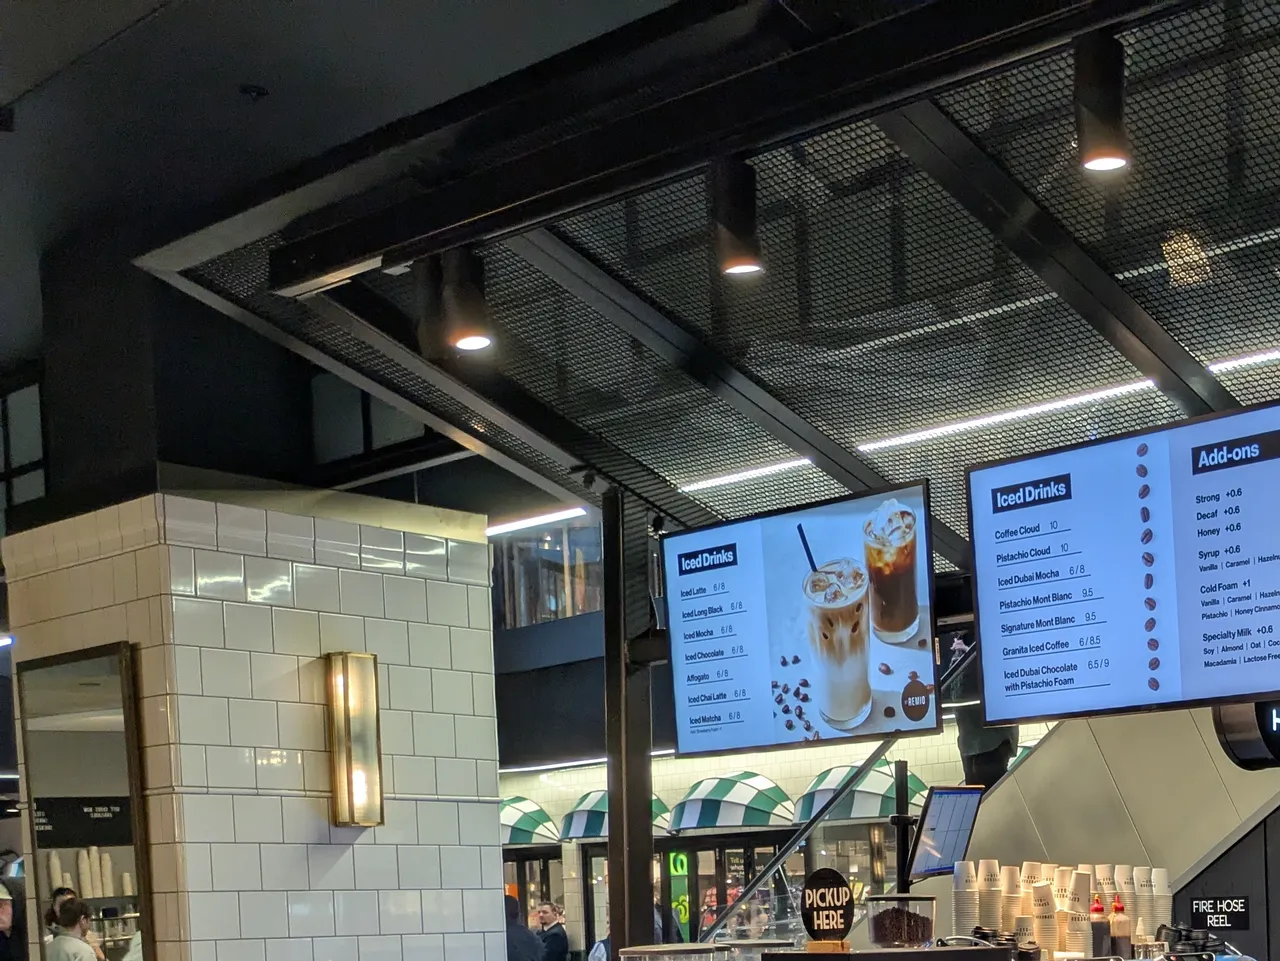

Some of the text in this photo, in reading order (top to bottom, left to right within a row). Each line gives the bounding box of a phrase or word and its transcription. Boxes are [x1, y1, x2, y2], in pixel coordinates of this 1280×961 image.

[1198, 444, 1260, 468] Add-ons
[997, 481, 1066, 507] Iced Drinks
[1196, 488, 1242, 504] Strong +0.6
[1197, 505, 1240, 520] Decaf +0.6
[995, 520, 1058, 539] Coffee Cloud 10
[1197, 522, 1242, 537] Honey +0.6
[682, 549, 734, 571] Iced Drinks
[996, 543, 1069, 563] Pistachio Cloud 10
[1198, 545, 1241, 560] Syrup +0.6
[1199, 563, 1218, 572] Vanilla
[1225, 558, 1250, 568] Caramel
[998, 576, 1013, 587] Iced
[1014, 573, 1035, 584] Dubai
[1035, 569, 1060, 580] Mocha
[680, 588, 692, 597] Iced
[692, 587, 707, 596] Latte
[1200, 579, 1251, 594] Cold Foam +1
[999, 588, 1094, 610] Pistachio Mont Blanc 9.5
[1201, 598, 1220, 607] Vanilla
[1227, 593, 1252, 603] Caramel
[682, 609, 694, 619] Iced
[694, 608, 708, 617] Long
[708, 605, 723, 615] Black
[1201, 610, 1229, 620] Pistachio
[1234, 606, 1254, 616] Honey
[1001, 611, 1096, 633] Signature Mont Blanc 9.5
[683, 630, 696, 640] Iced
[696, 629, 714, 638] Mocha
[1202, 625, 1273, 643] Specialty Milk +0.6
[685, 652, 697, 661] Iced
[696, 649, 724, 660] Chocolate
[1002, 645, 1028, 656] Granita
[1029, 643, 1044, 653] Iced
[1045, 640, 1070, 650] Coffee
[1203, 647, 1215, 655] Soy
[1221, 643, 1243, 653] Almond
[1250, 641, 1261, 649] Oat
[1203, 658, 1237, 668] Macadamia
[1243, 654, 1267, 664] Lactose
[686, 673, 710, 682] Affogato
[1003, 669, 1019, 679] Iced
[1020, 667, 1040, 677] Dubai
[1041, 663, 1078, 675] Chocolate
[1004, 677, 1075, 692] with Pistachio Foam
[687, 695, 700, 704] Iced
[700, 693, 712, 702] Chai
[712, 692, 727, 701] Latte
[689, 716, 701, 725] Iced
[701, 714, 722, 723] Matcha
[805, 886, 850, 908] PICKUP
[1193, 899, 1245, 913] FIRE HOSE
[813, 910, 845, 930] HERE
[1207, 914, 1231, 927] REEL
